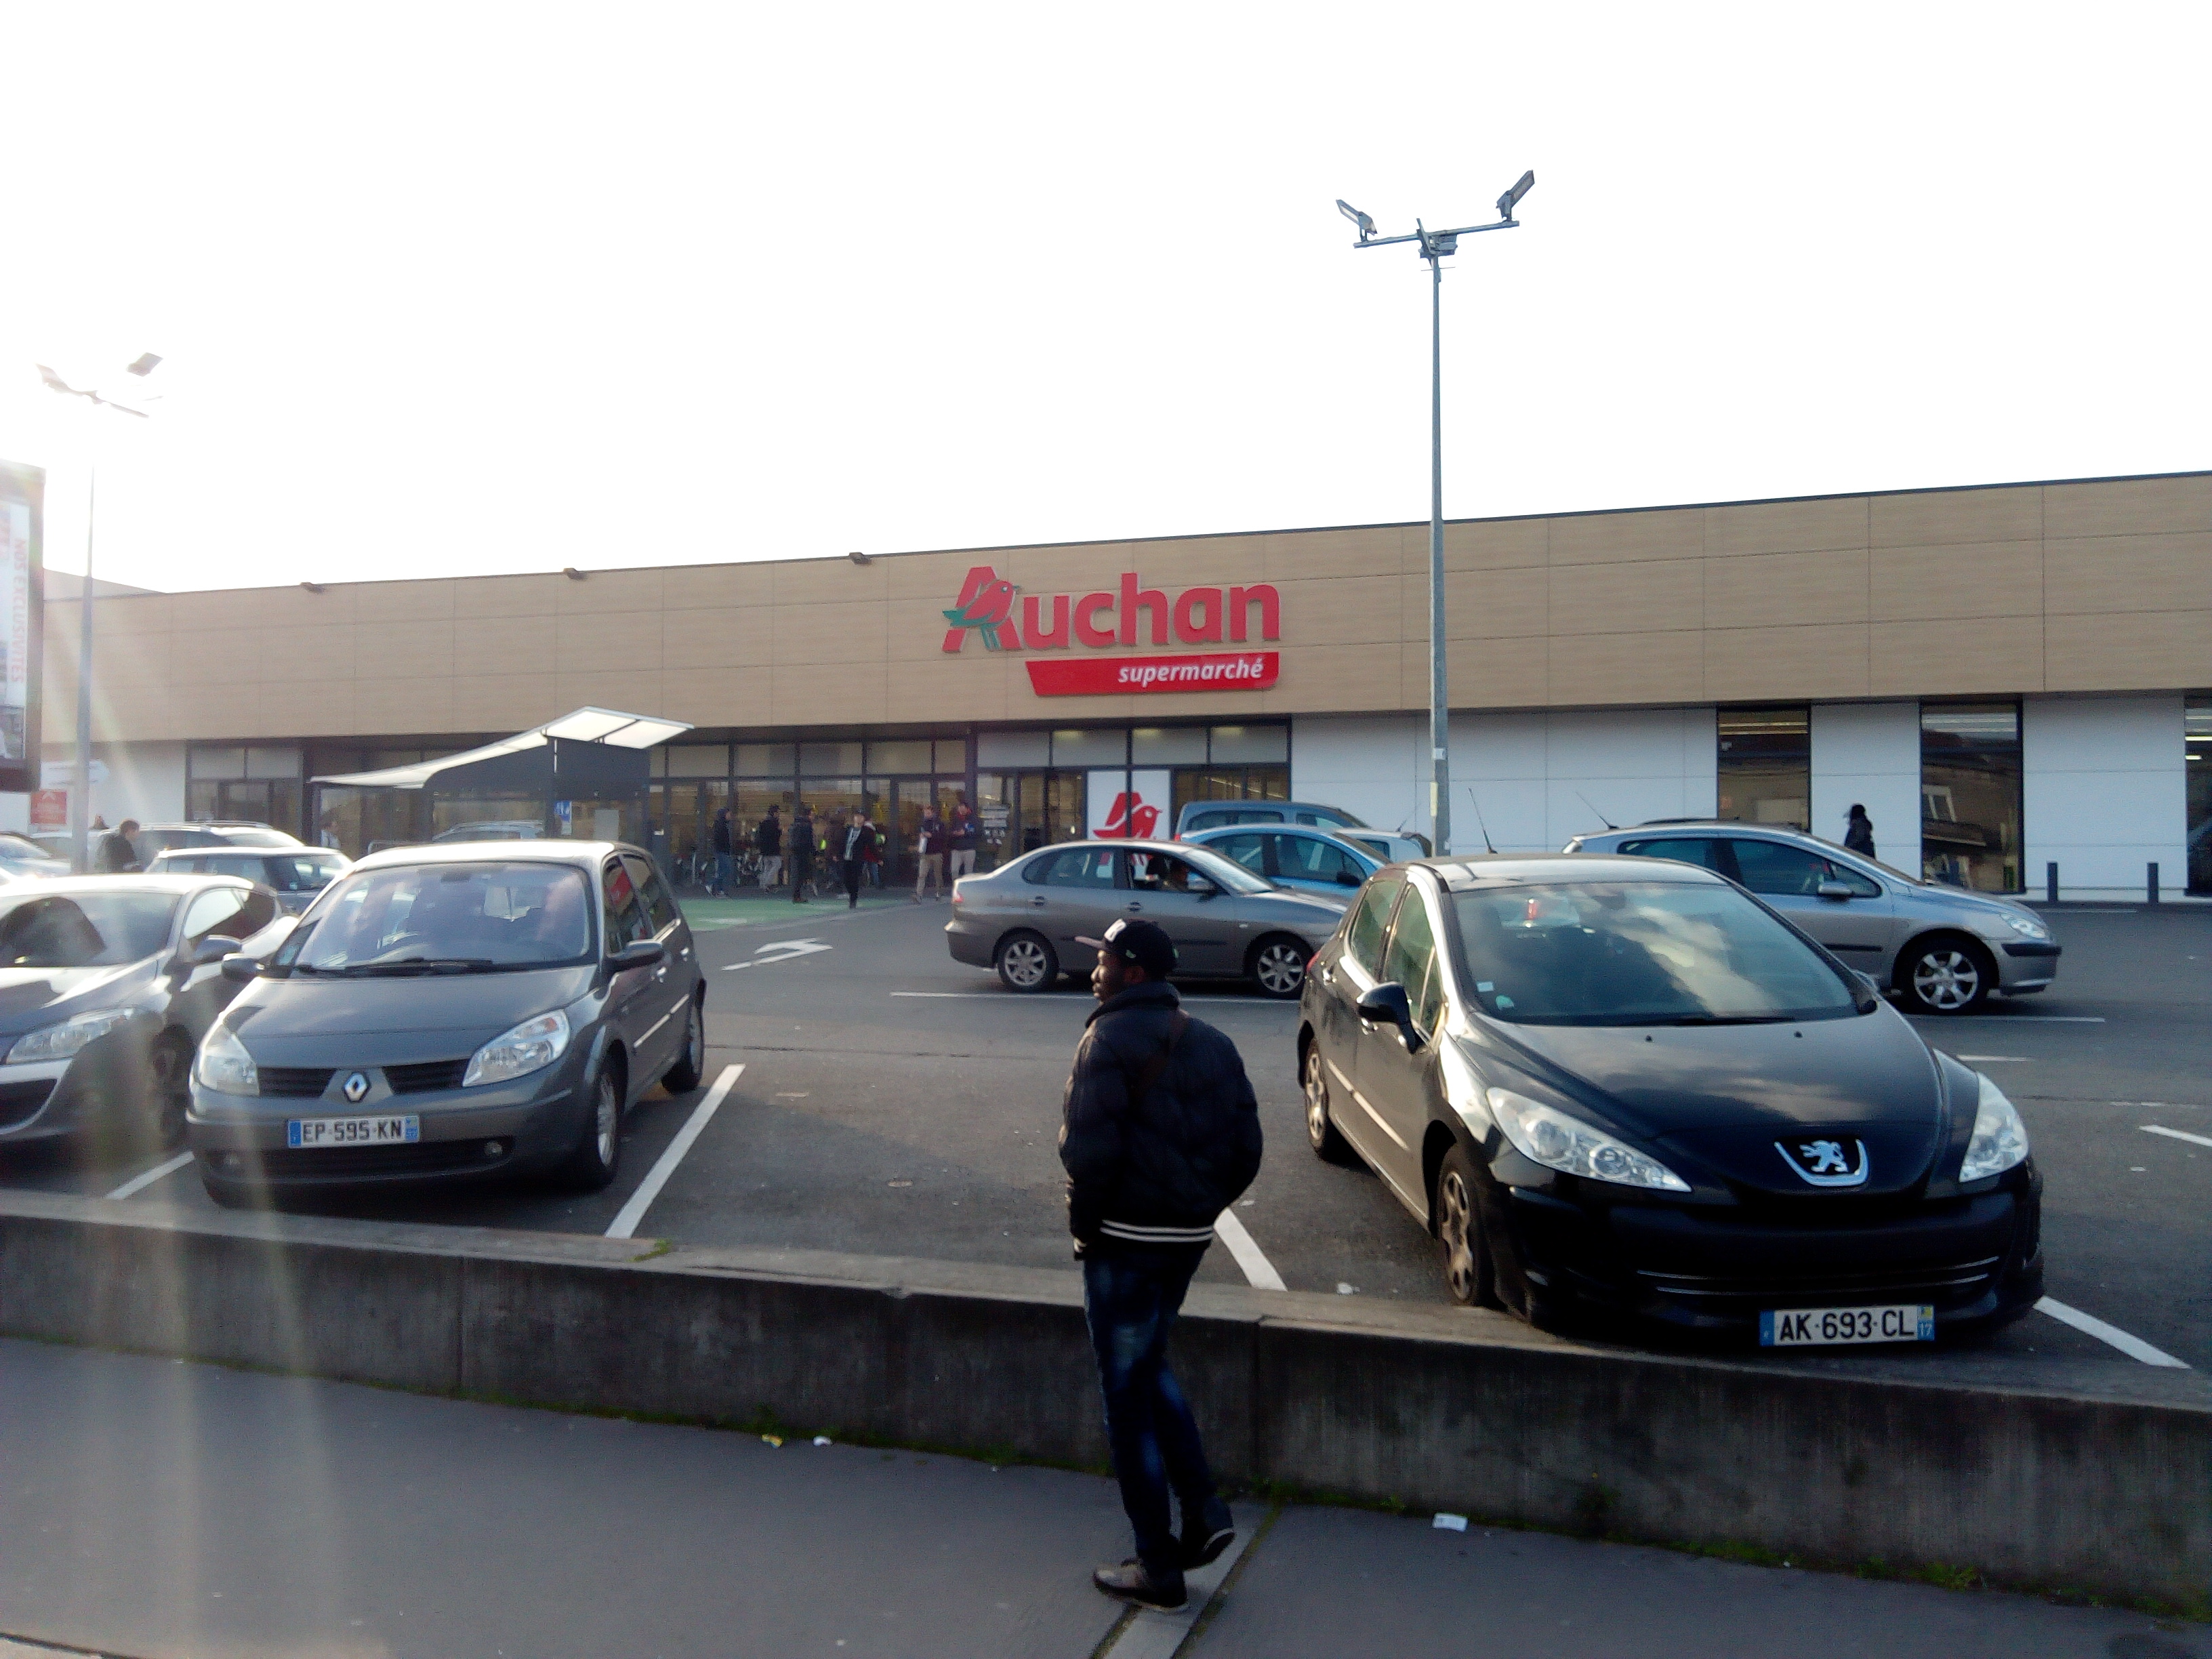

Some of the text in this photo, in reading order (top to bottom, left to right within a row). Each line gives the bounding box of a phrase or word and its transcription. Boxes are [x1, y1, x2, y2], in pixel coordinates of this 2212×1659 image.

[13, 538, 27, 571] NOS
[942, 566, 1280, 652] Auchan
[1118, 657, 1264, 688] supermarché
